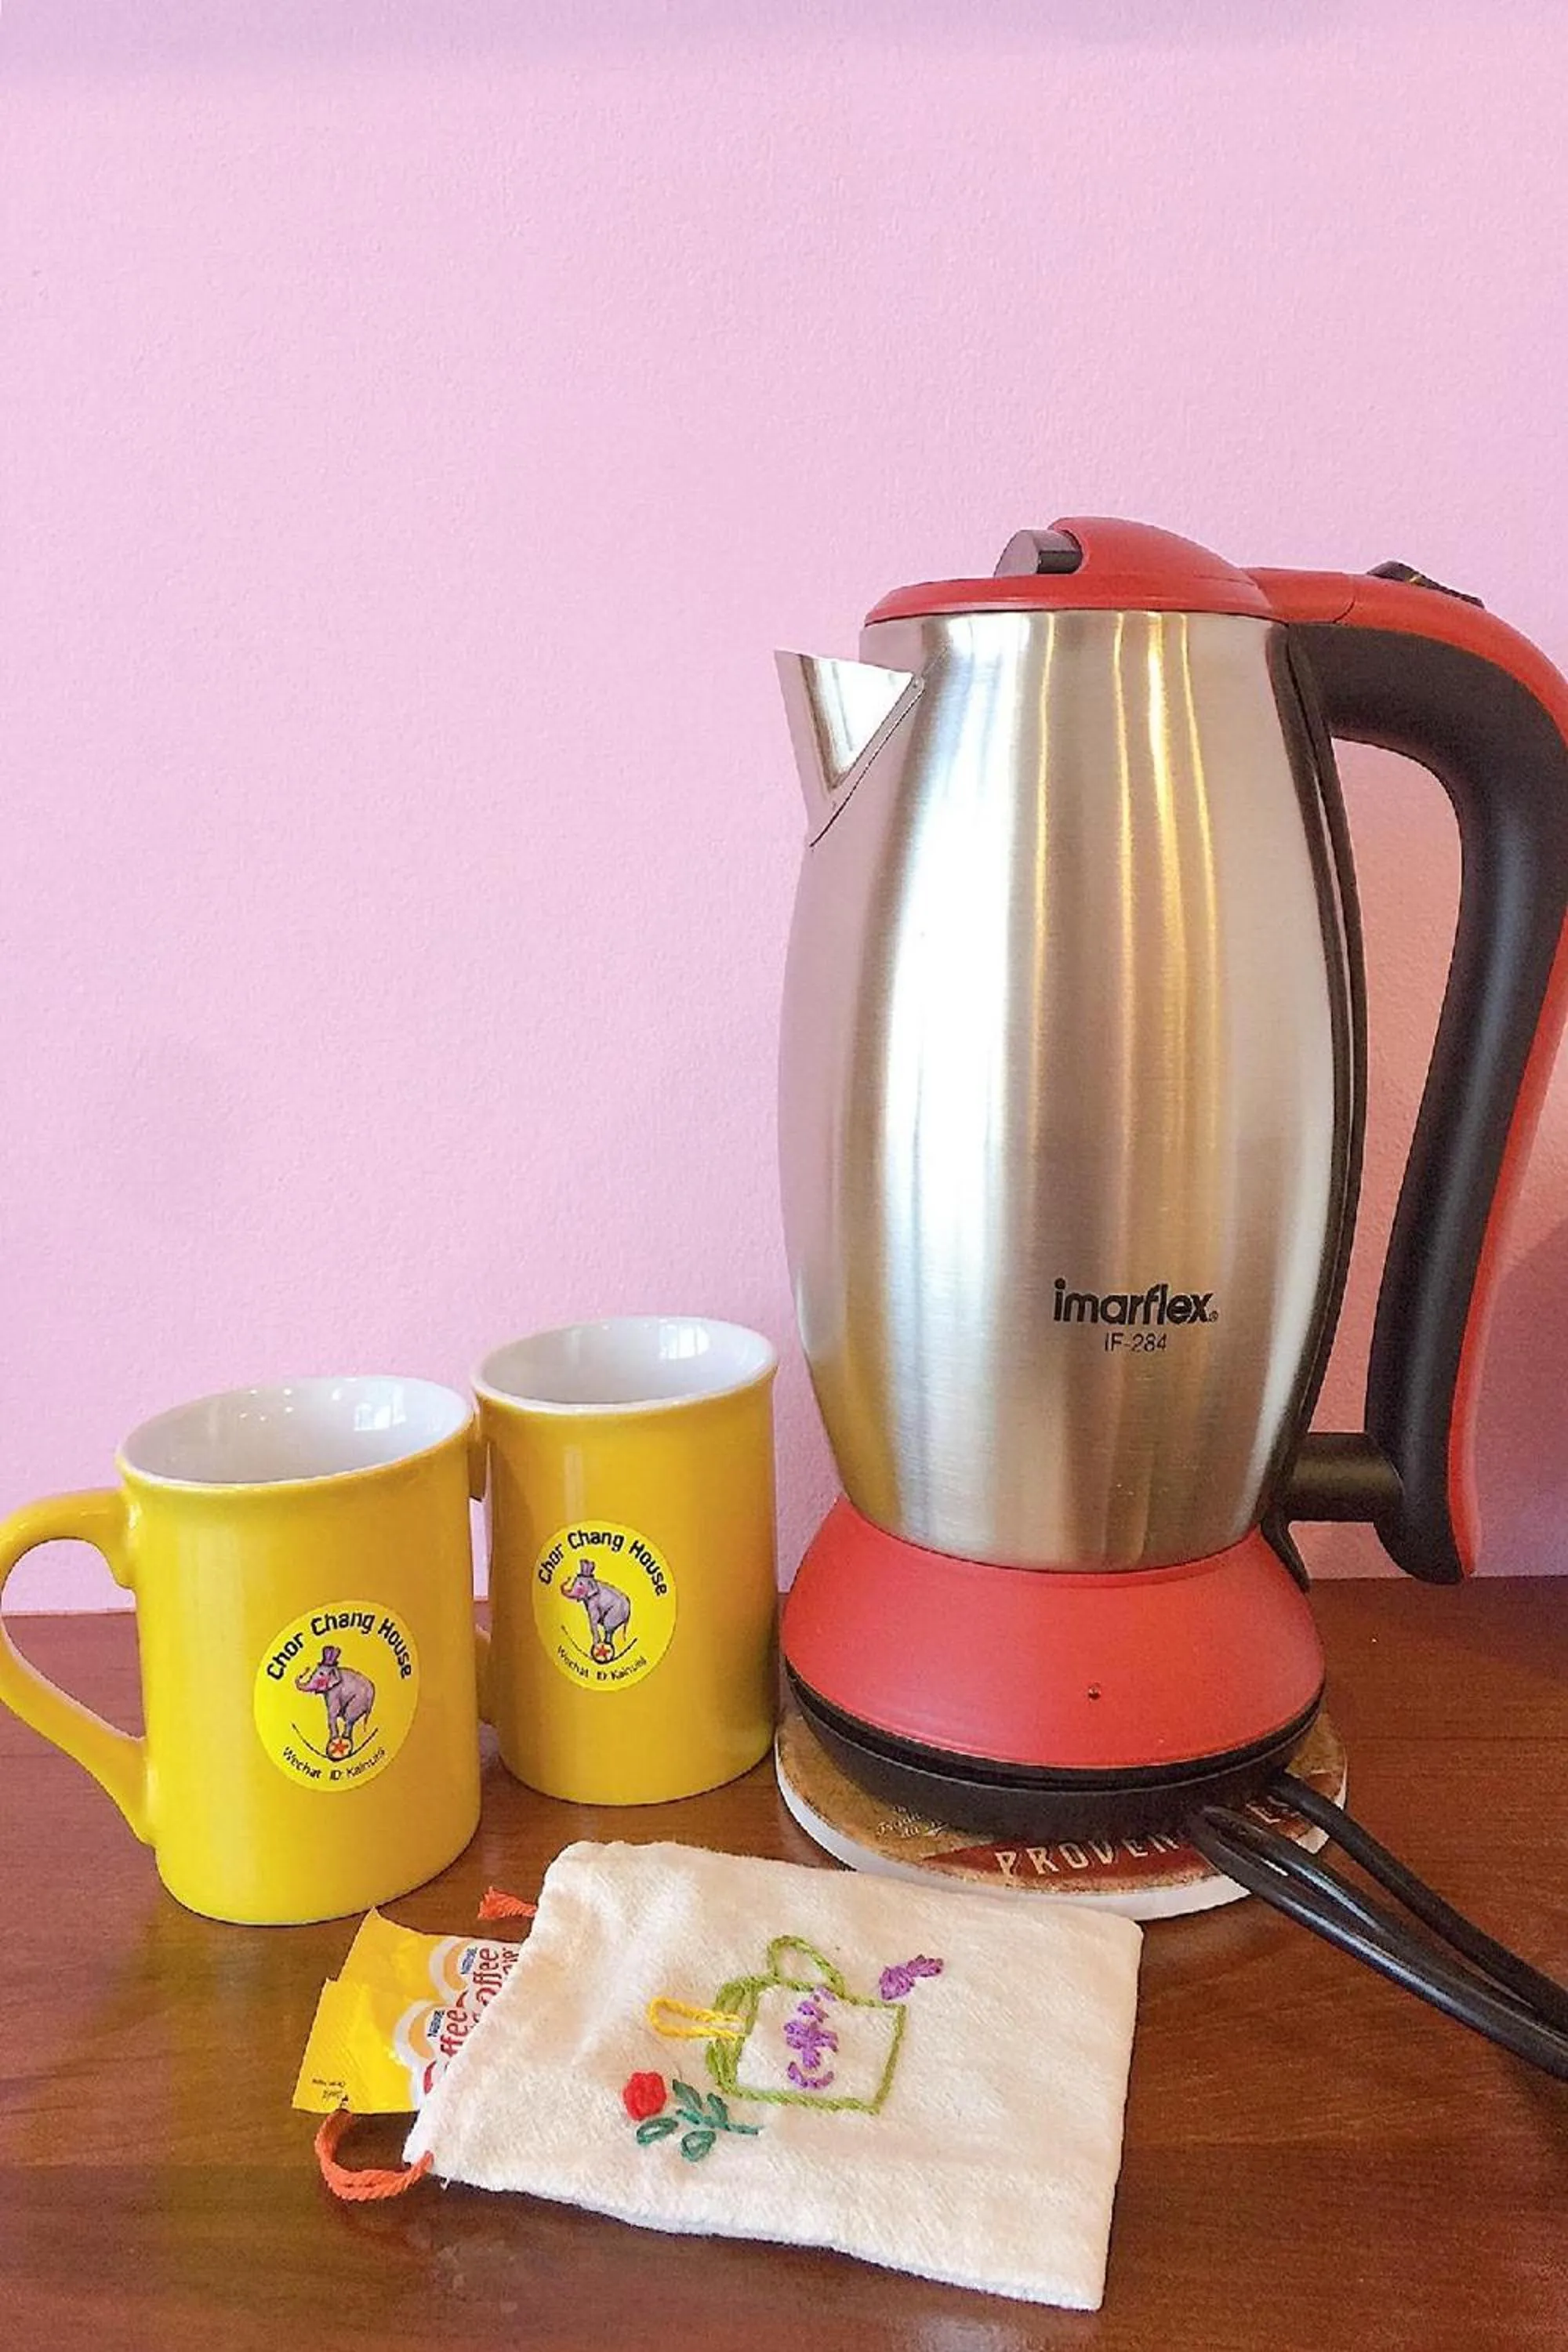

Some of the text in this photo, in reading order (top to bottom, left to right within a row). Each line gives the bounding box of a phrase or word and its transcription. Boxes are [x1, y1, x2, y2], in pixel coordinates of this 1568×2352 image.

[1105, 1333, 1167, 1352] IF-284
[539, 1530, 668, 1595] Chor Chang House
[267, 1613, 412, 1680] Chor Chang House
